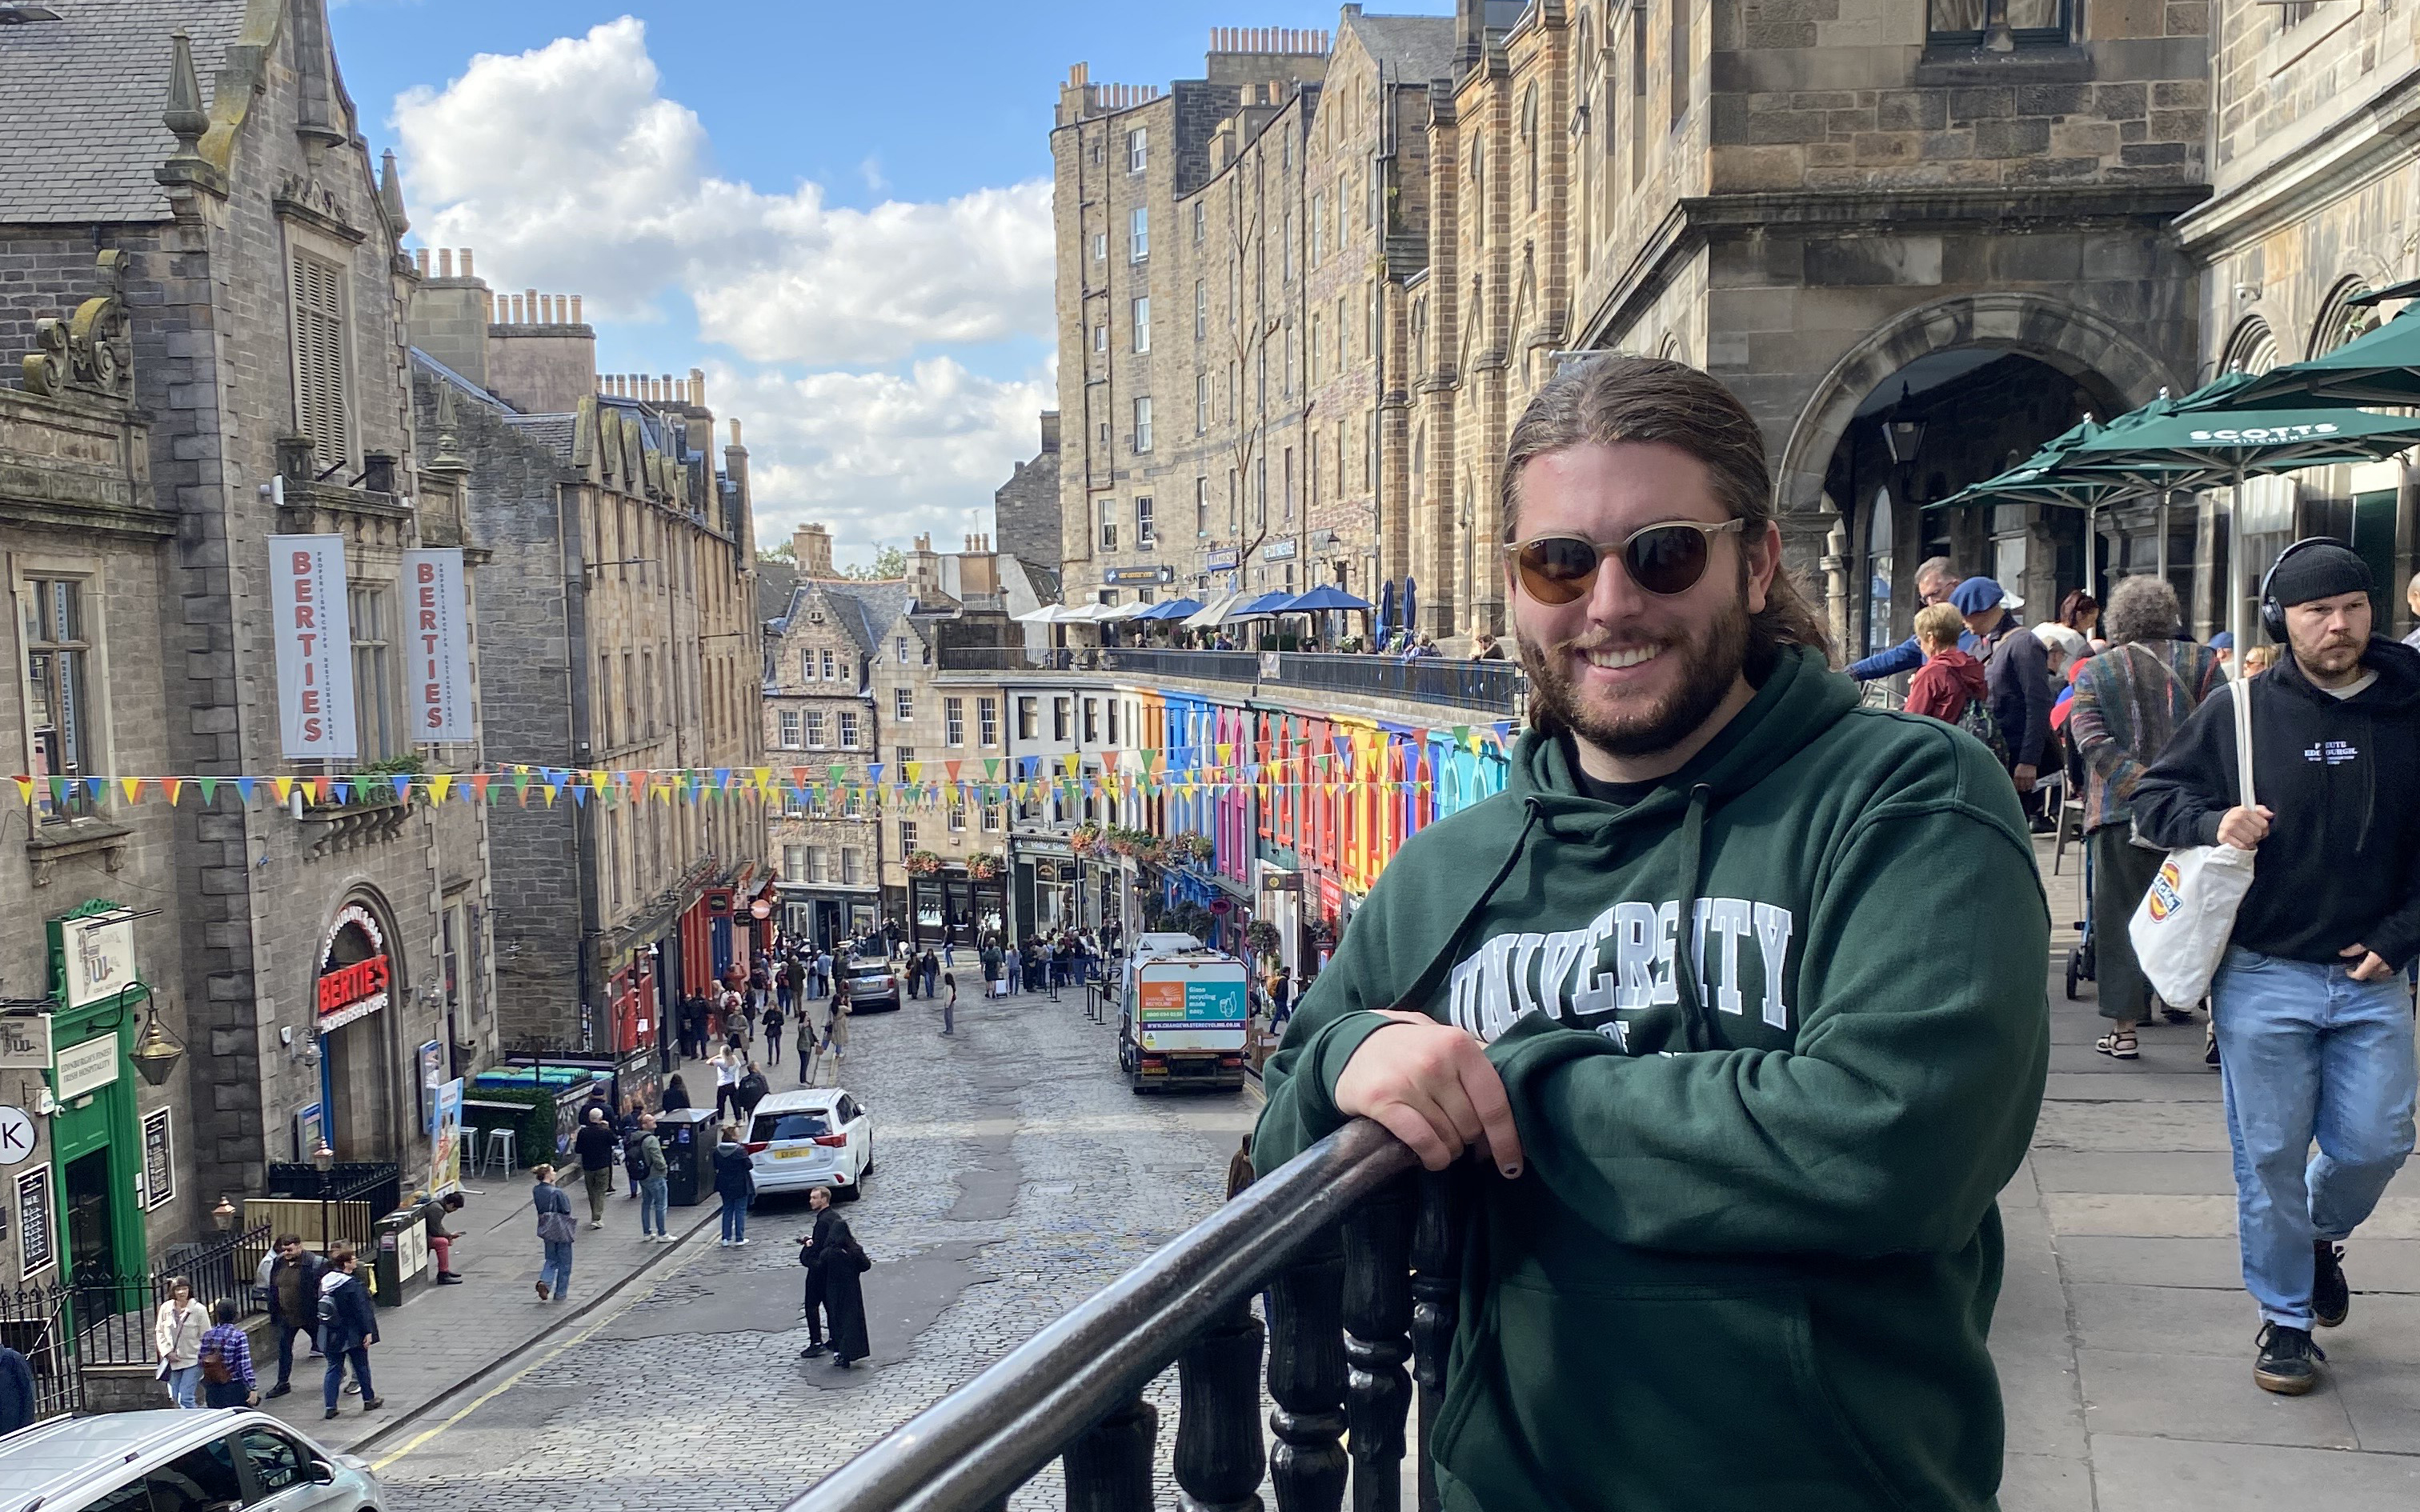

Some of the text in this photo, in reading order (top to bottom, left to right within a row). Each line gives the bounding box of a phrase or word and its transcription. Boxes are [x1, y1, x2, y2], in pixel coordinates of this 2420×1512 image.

[2190, 423, 2339, 439] SCOTTS
[2233, 434, 2299, 444] KITCHEN
[291, 551, 322, 742] BERTIES
[417, 562, 443, 728] BERTIES
[323, 658, 332, 715] RESTAURANT
[321, 906, 364, 968] RESTAURANT
[1449, 897, 1793, 1044] UNIVERSITY
